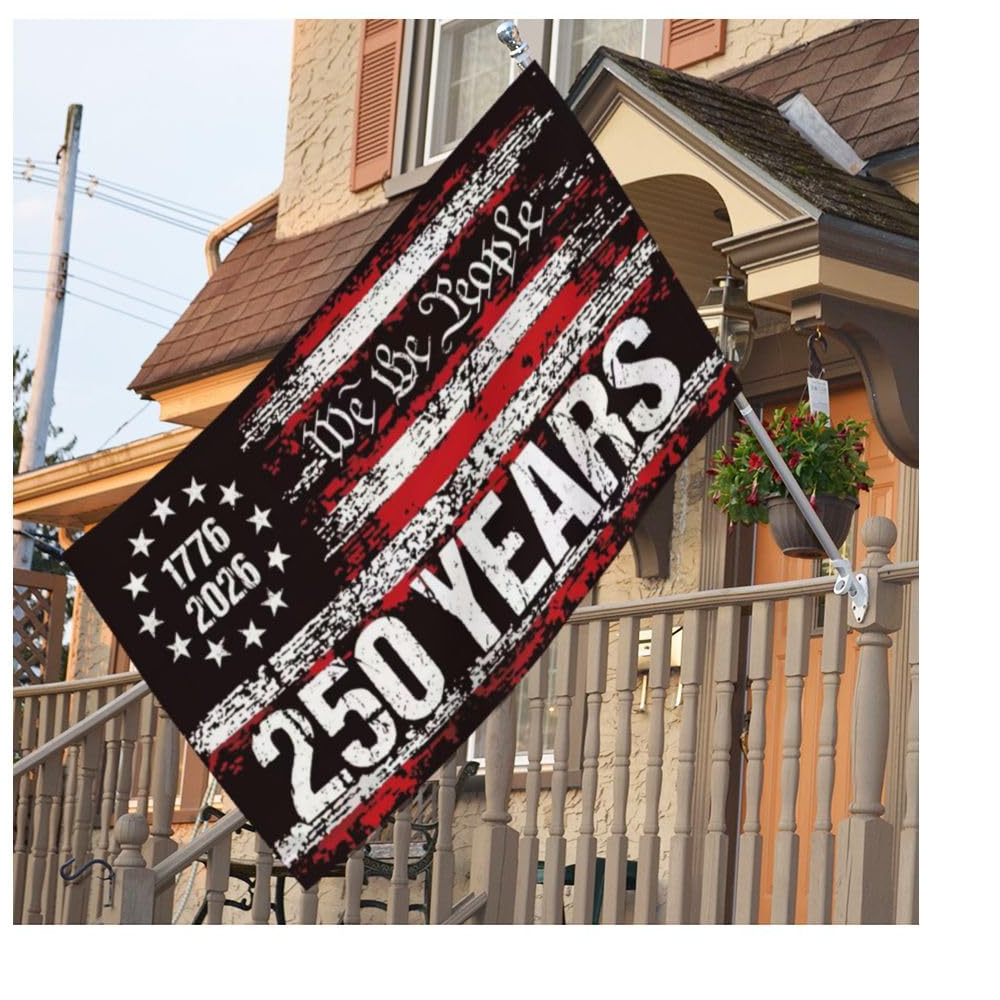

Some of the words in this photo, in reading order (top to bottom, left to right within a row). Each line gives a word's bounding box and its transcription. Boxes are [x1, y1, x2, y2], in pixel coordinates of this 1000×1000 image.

[302, 382, 378, 467] We
[370, 323, 432, 404] the
[419, 199, 546, 355] People
[160, 517, 231, 592] 1776
[183, 552, 260, 633] 2026
[250, 616, 447, 823] 250
[410, 316, 682, 651] YEARS
